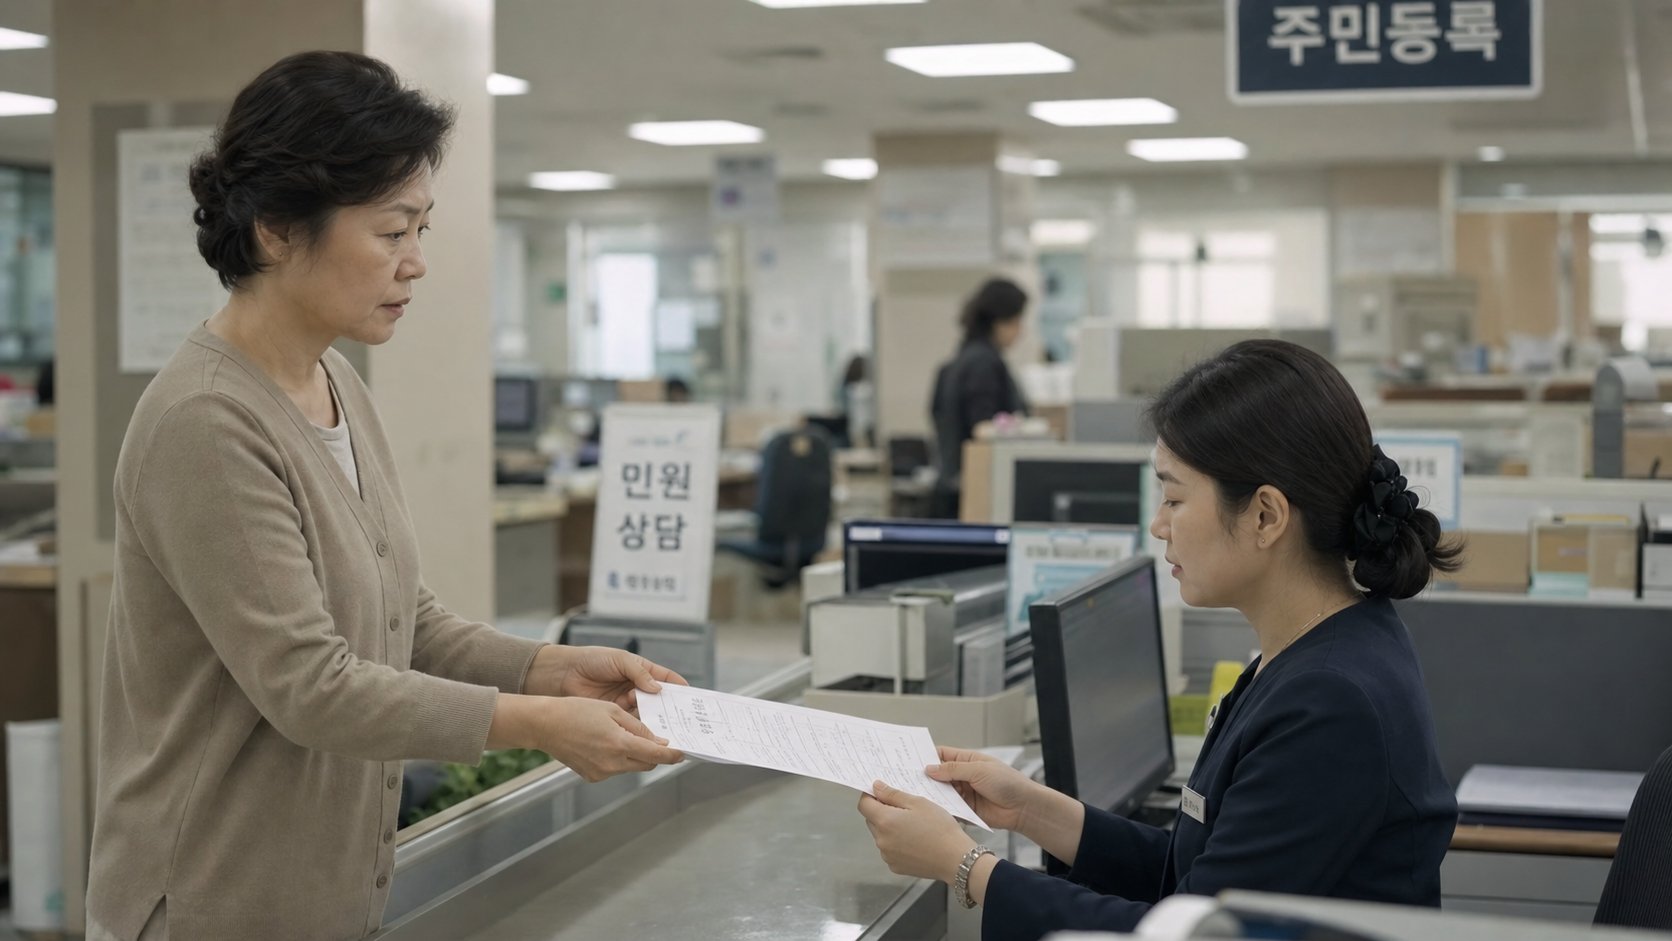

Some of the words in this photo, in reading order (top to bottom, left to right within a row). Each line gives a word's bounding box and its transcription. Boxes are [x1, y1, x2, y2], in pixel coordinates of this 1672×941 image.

[1267, 1, 1501, 66] 주민등록
[621, 461, 690, 500] 민원
[617, 513, 687, 551] 상담
